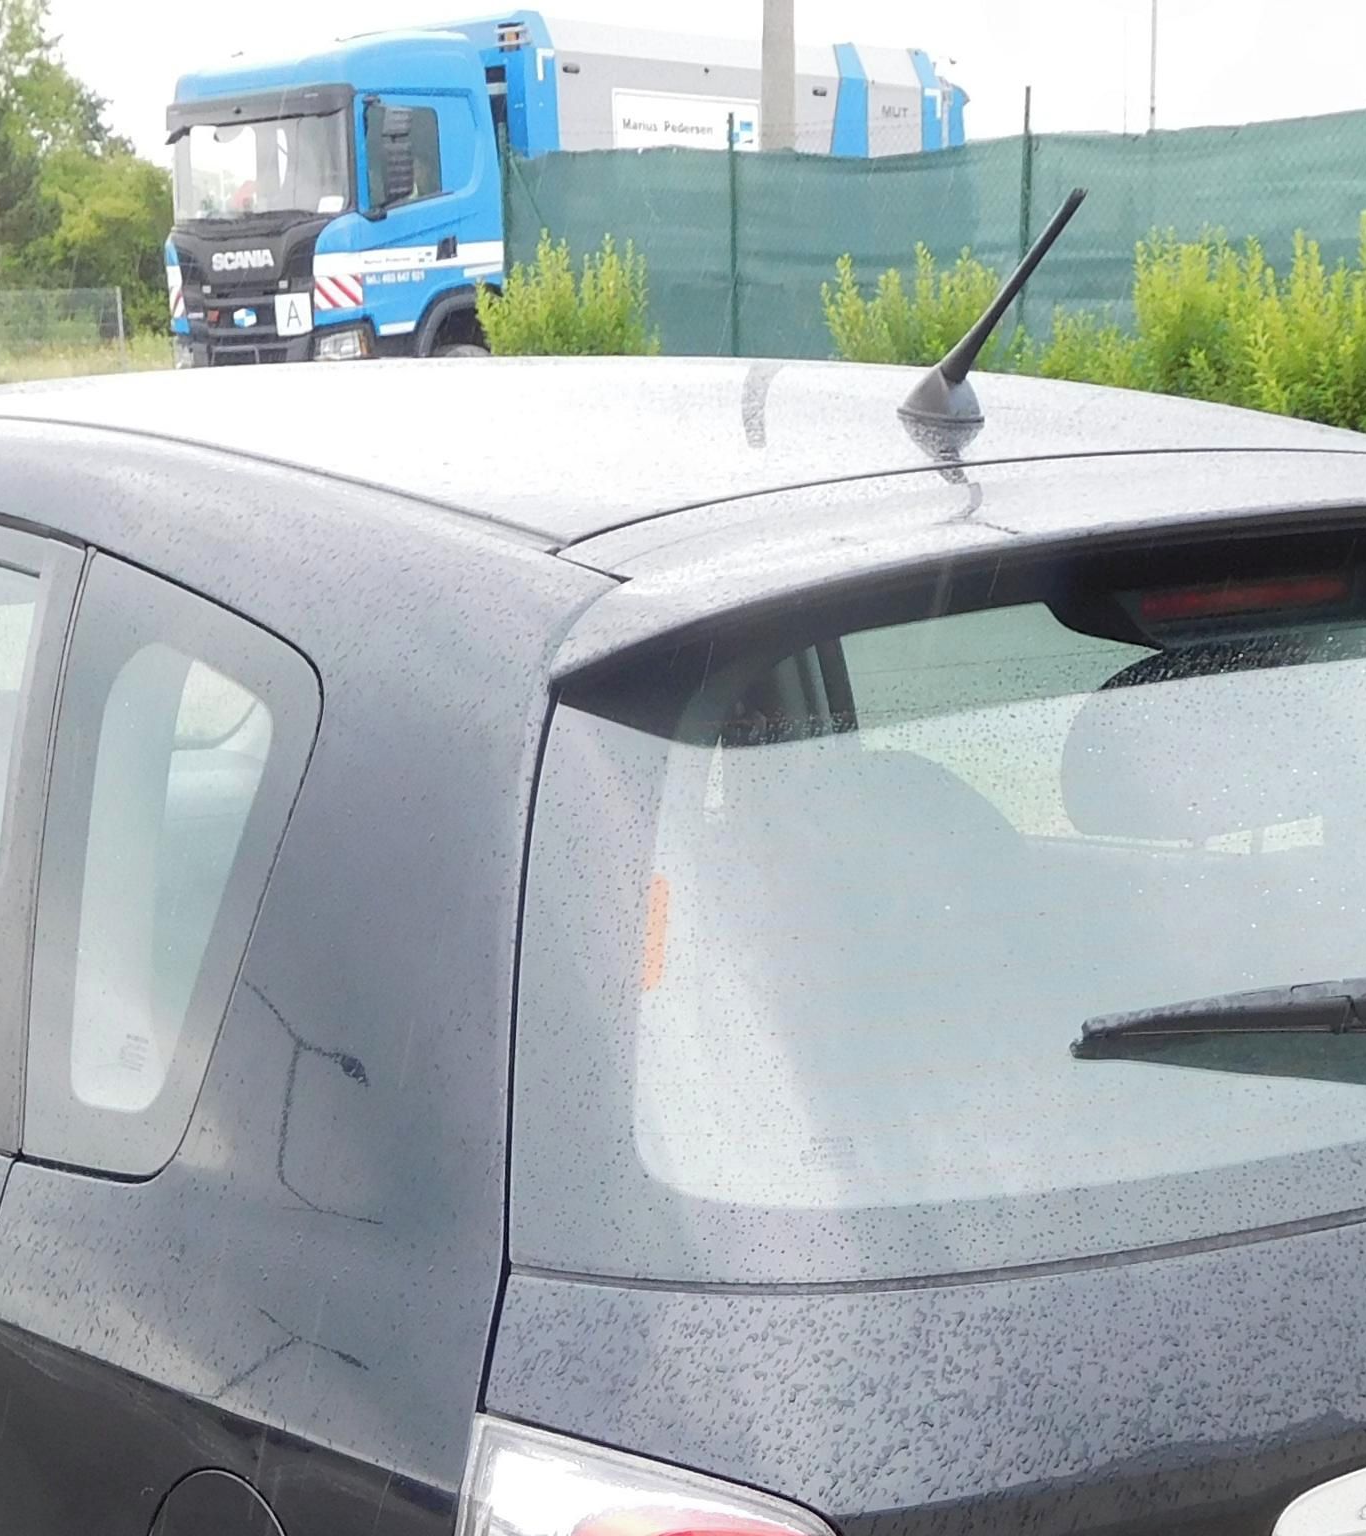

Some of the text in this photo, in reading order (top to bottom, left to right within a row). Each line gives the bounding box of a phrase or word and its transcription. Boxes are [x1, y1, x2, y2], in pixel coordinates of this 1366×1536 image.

[622, 117, 714, 136] Marius Pedersen
[211, 248, 275, 272] SCANIA
[286, 299, 303, 329] A
